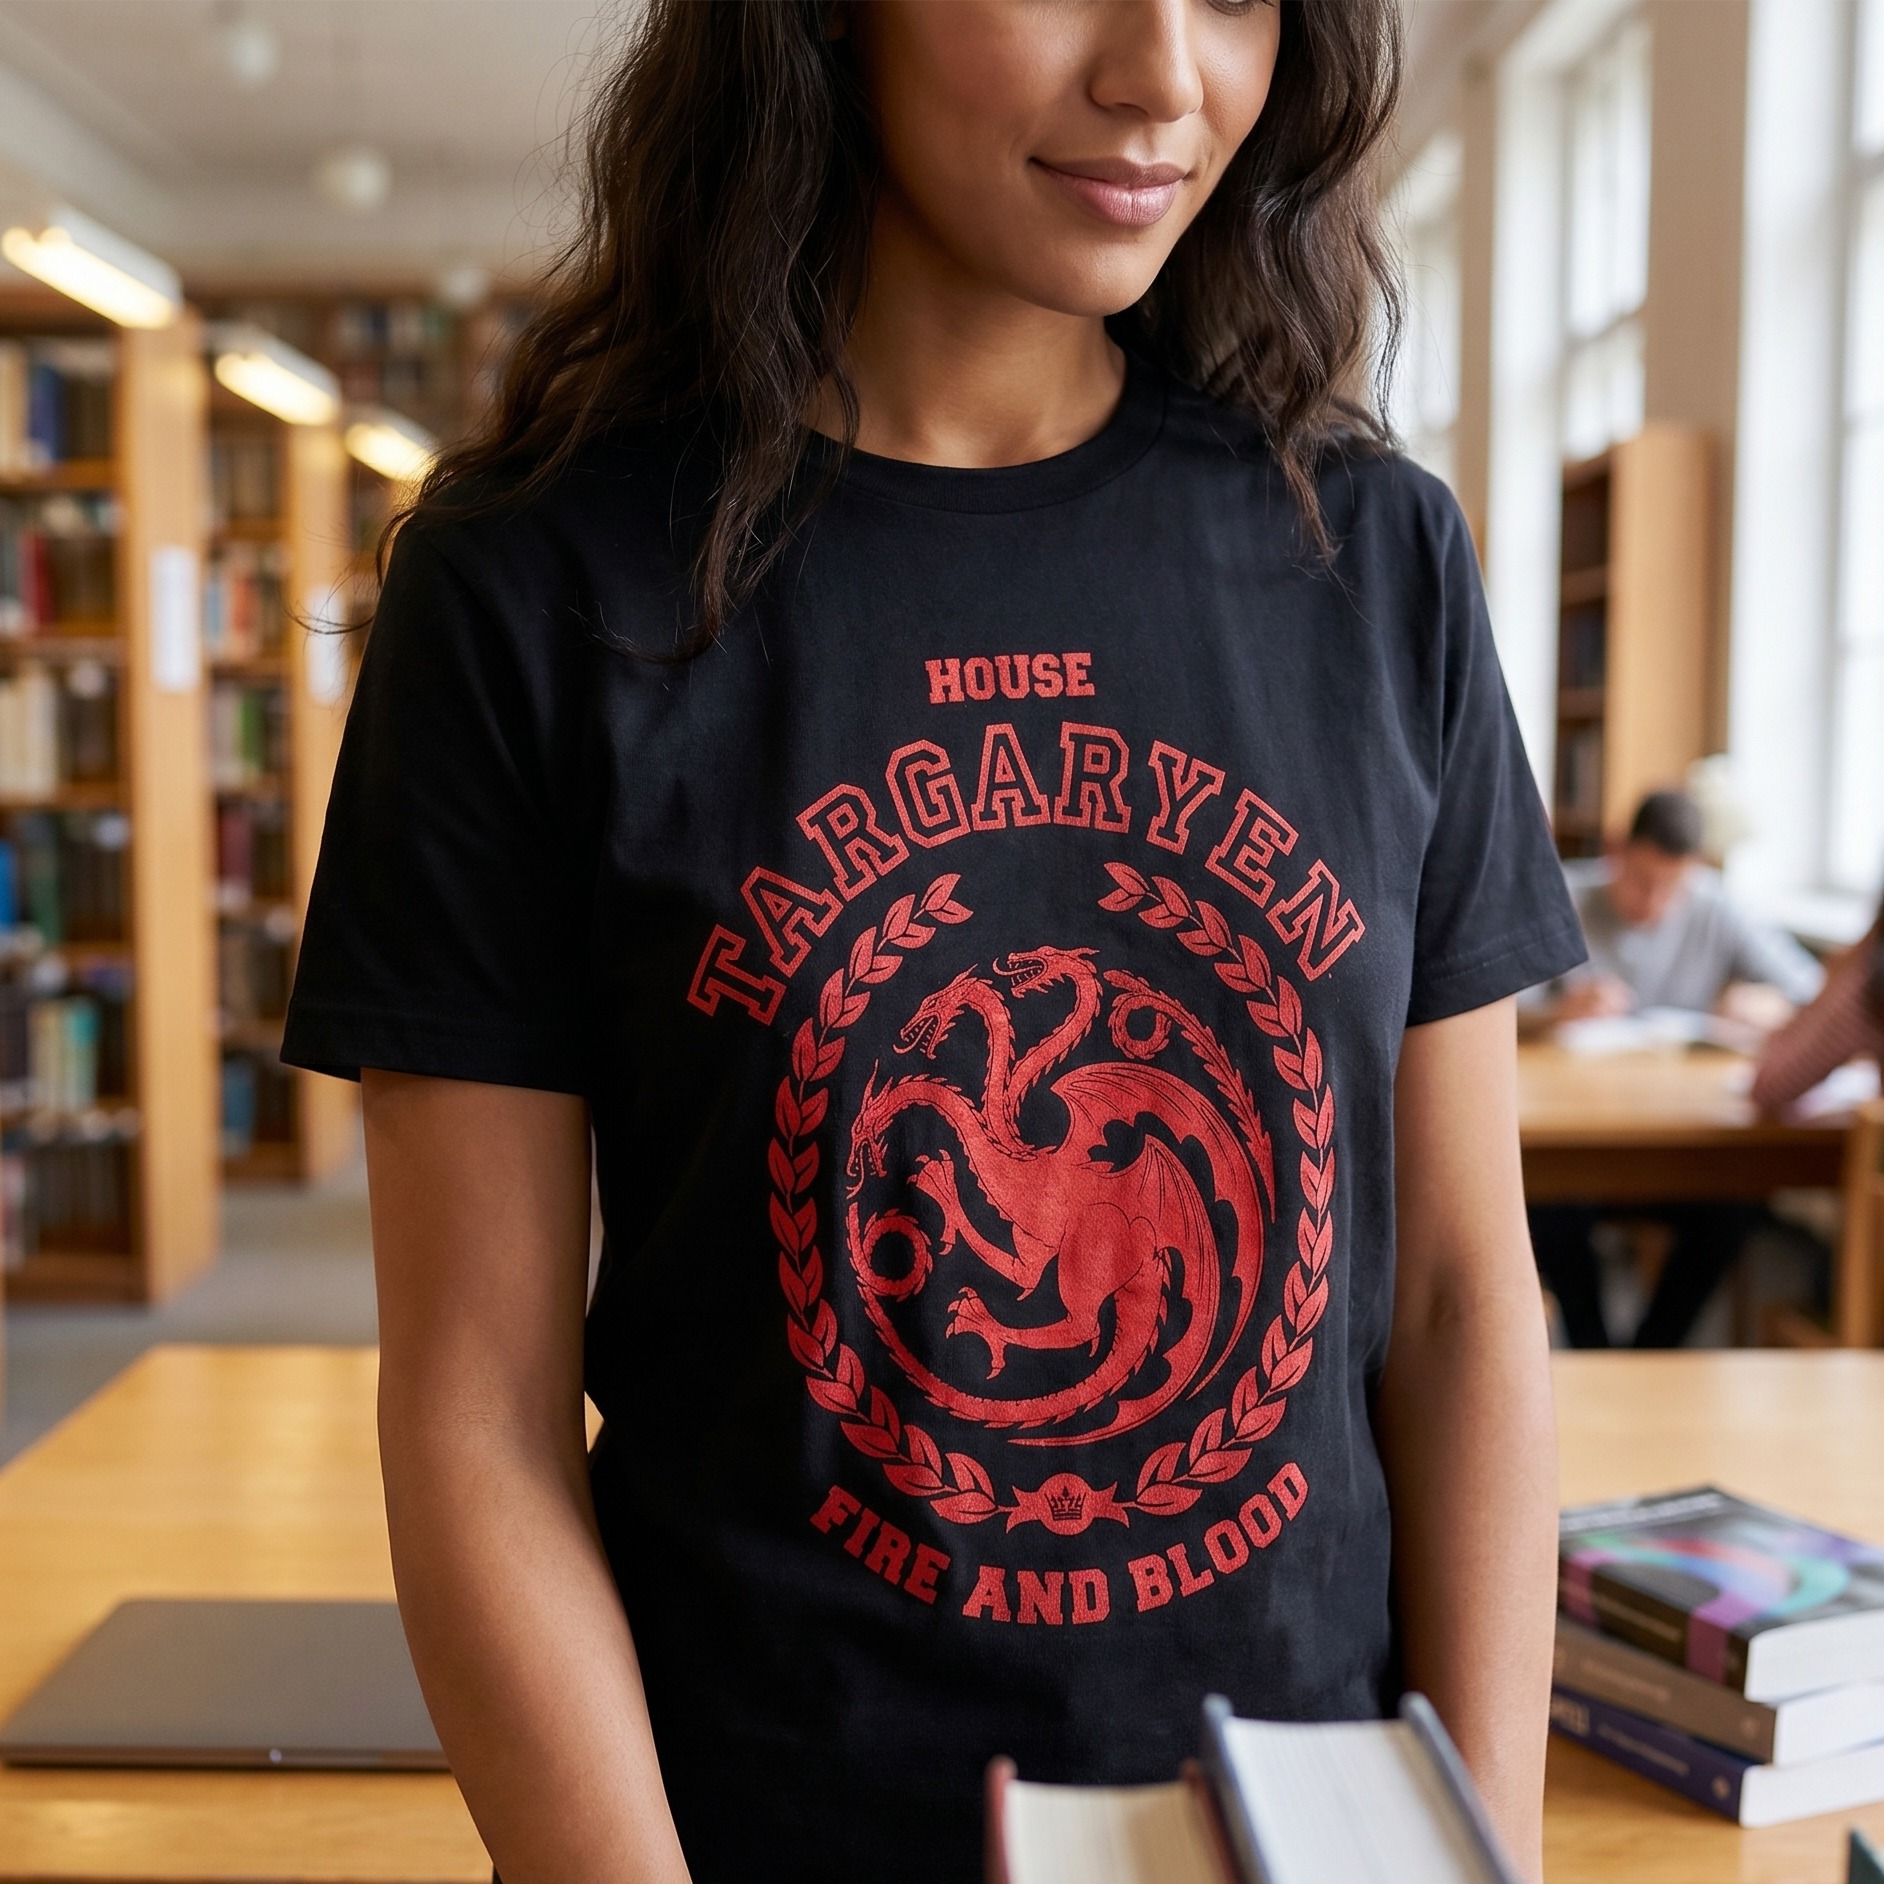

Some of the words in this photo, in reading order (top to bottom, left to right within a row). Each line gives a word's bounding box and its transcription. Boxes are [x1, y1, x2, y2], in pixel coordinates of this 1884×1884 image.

[924, 651, 1097, 705] HOUSE
[686, 720, 1366, 1026] TARGARYEN
[809, 1484, 952, 1605] FIRE
[961, 1564, 1112, 1626] AND
[1127, 1461, 1310, 1613] BLOOD
